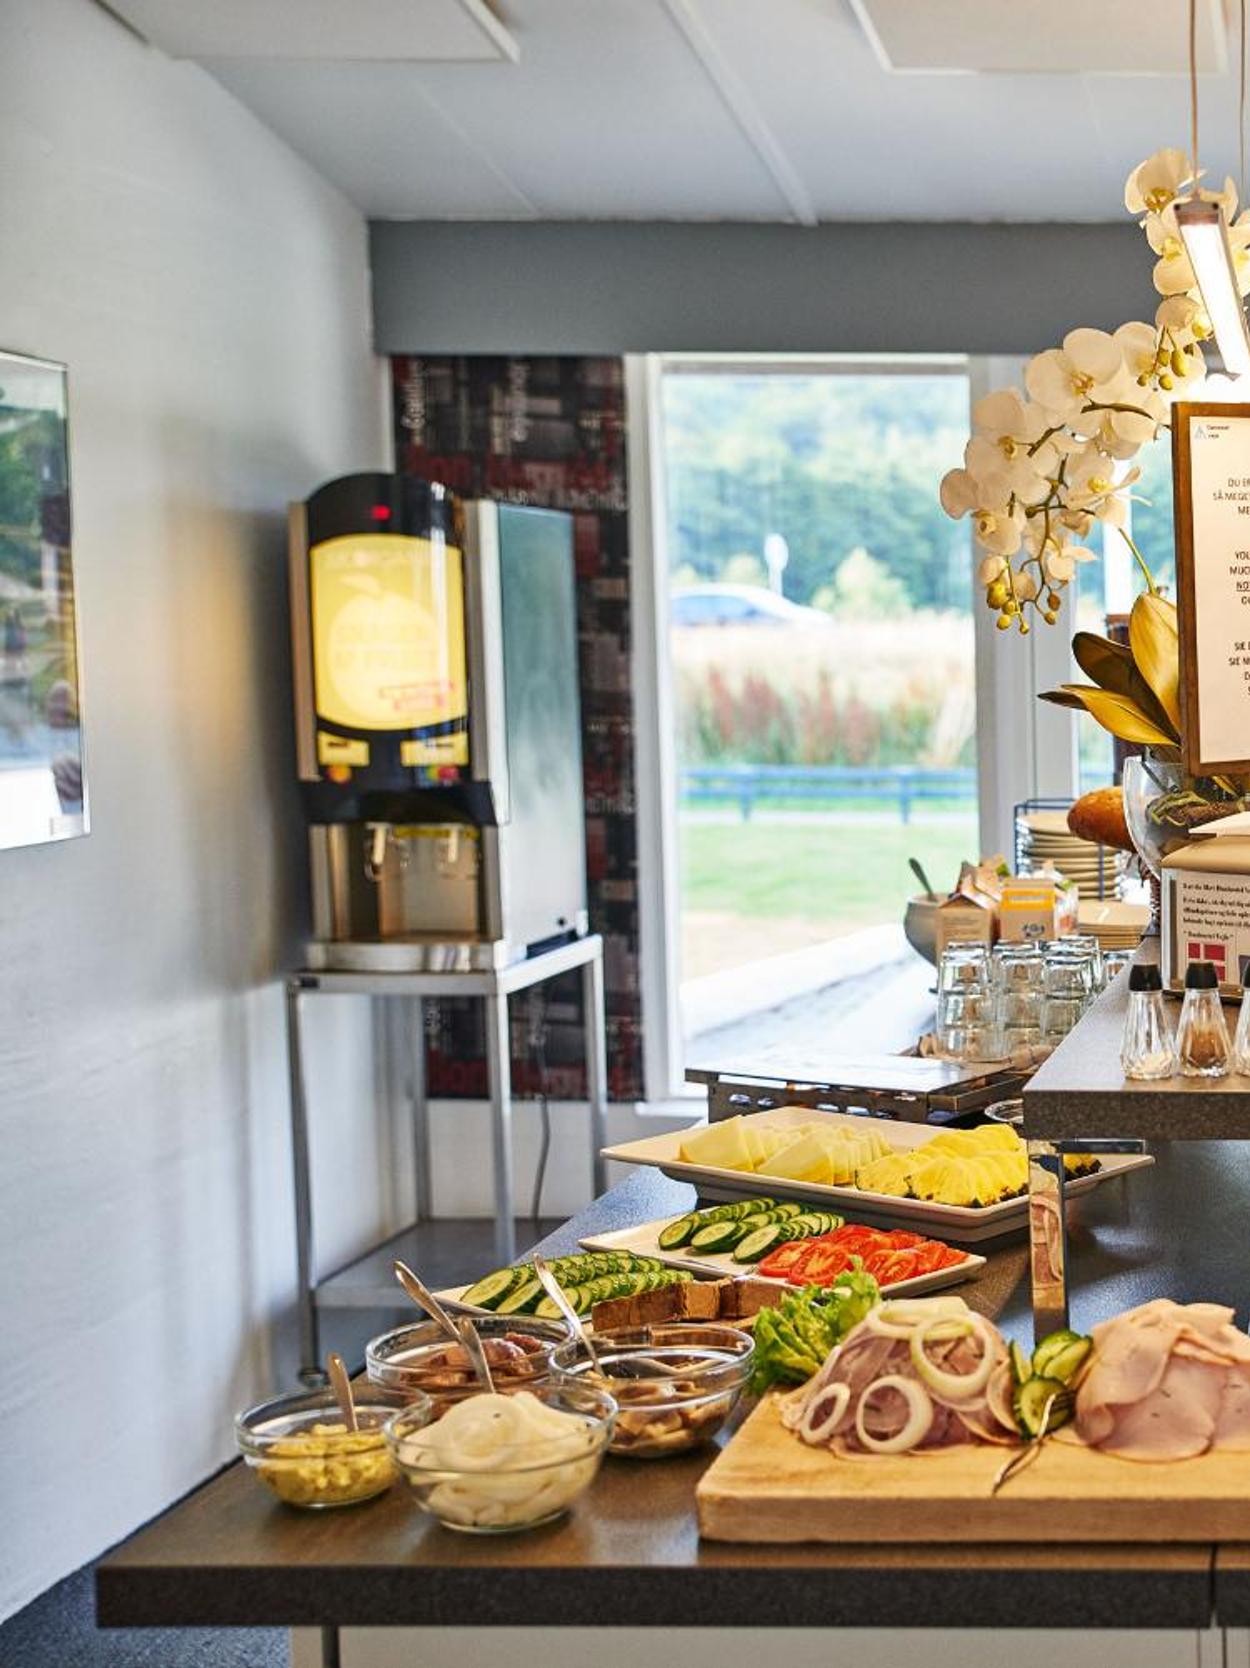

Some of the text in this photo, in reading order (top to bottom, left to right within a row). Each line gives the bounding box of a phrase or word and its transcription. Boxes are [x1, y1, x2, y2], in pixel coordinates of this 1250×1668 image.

[1228, 479, 1240, 487] DU
[1234, 642, 1245, 650] SIE
[1229, 657, 1239, 665] SIE
